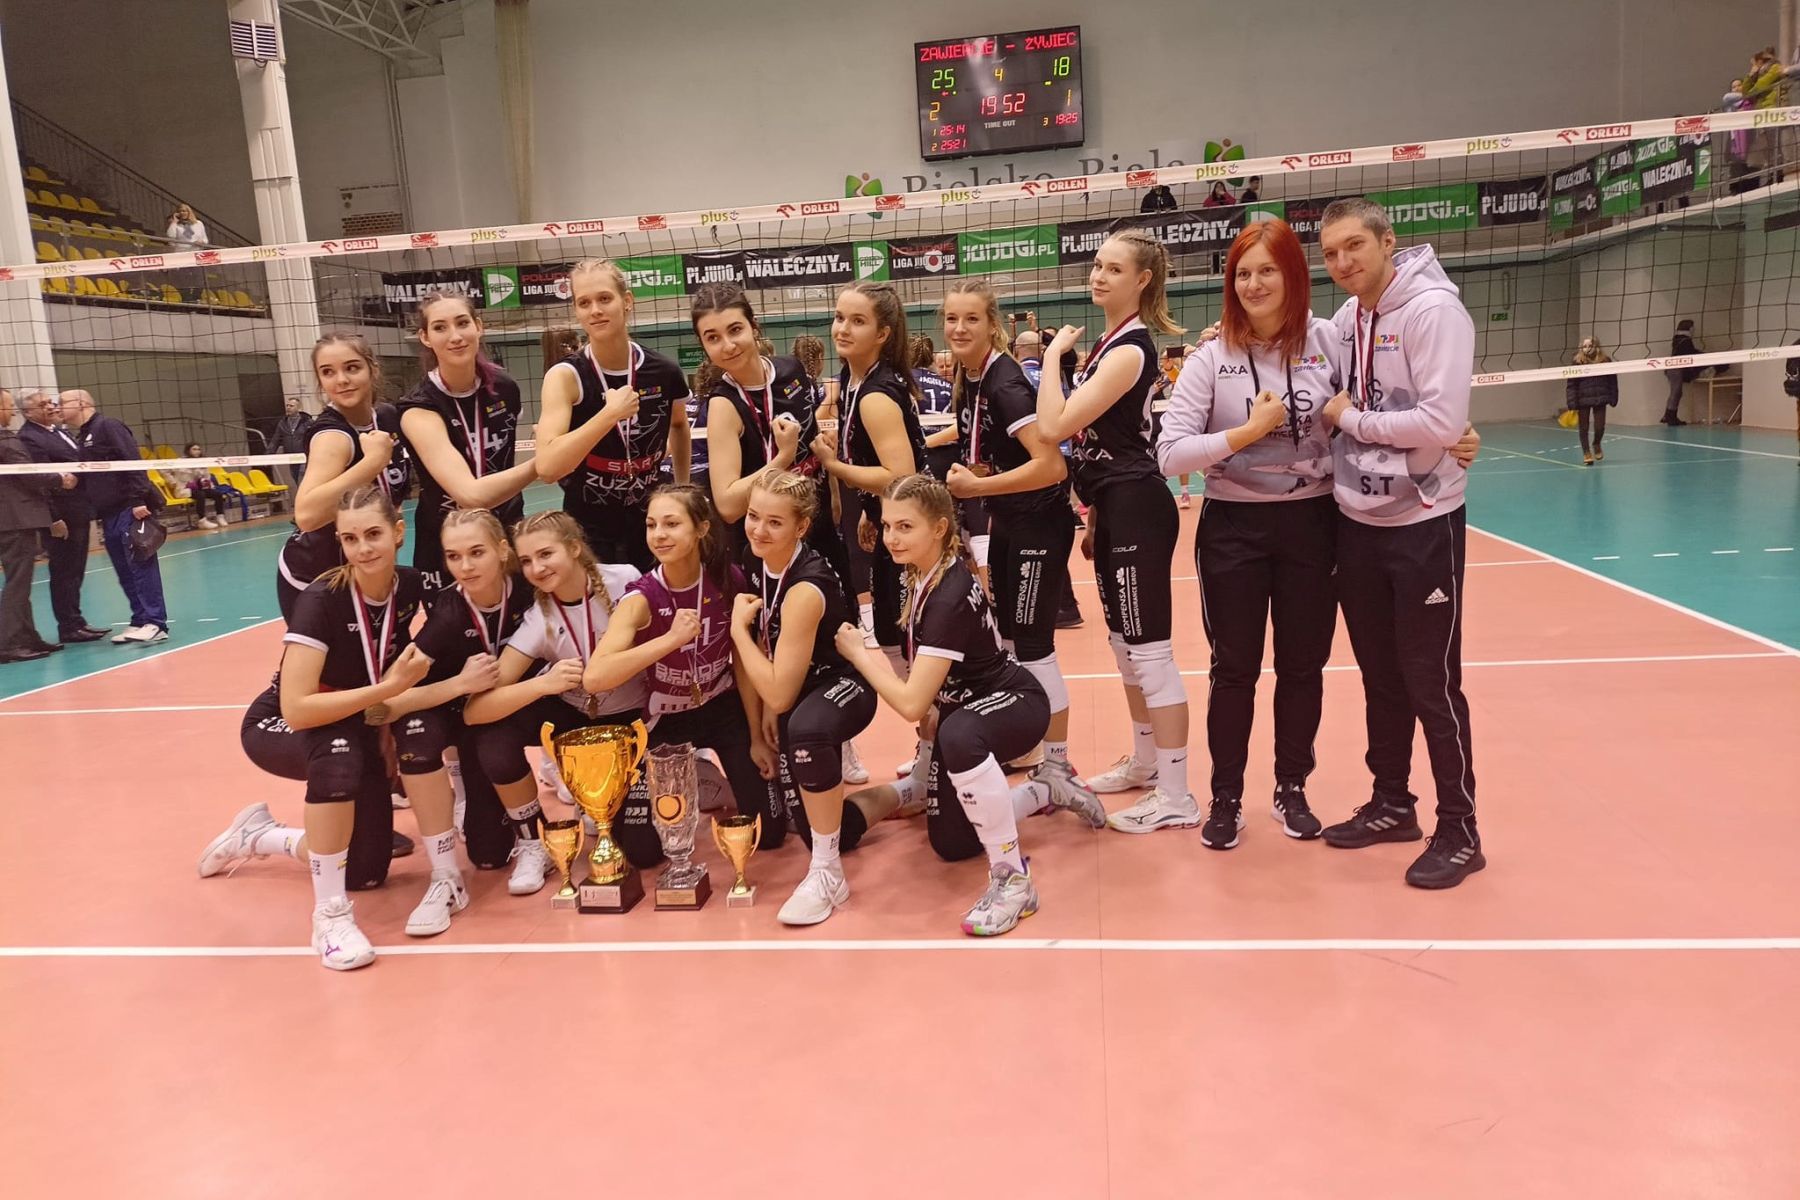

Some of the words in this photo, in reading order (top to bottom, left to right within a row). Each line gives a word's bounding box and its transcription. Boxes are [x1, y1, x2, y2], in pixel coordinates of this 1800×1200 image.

[1053, 56, 1070, 77] 18
[932, 68, 955, 90] 25
[994, 68, 1003, 82] 4
[929, 102, 940, 121] 2
[984, 121, 1001, 129] TIME
[1042, 117, 1049, 126] 3
[1754, 111, 1787, 127] plus
[1588, 126, 1630, 139] ORLEN
[931, 143, 938, 152] 2
[1467, 138, 1499, 154] plus
[1310, 153, 1350, 166] ORLEN
[1196, 165, 1227, 180] plus
[1049, 179, 1086, 192] ORLEN
[941, 190, 971, 205] plus
[802, 202, 838, 214] ORLEN
[1384, 200, 1475, 224] DOGI.PL
[701, 210, 729, 226] plus
[569, 222, 603, 233] ORLEN
[1144, 220, 1240, 244] ALECZNY.P
[471, 229, 497, 243] plus
[344, 239, 378, 250] ORLEN
[252, 246, 278, 260] plus
[132, 256, 163, 268] ORLEN
[893, 258, 913, 269] LIGA
[523, 285, 543, 295] LIGA
[1218, 364, 1249, 375] AXA
[1360, 475, 1394, 496] S.T
[421, 571, 443, 590] 24
[1016, 579, 1028, 624] COMPENSA
[1119, 587, 1131, 636] COMPENSA
